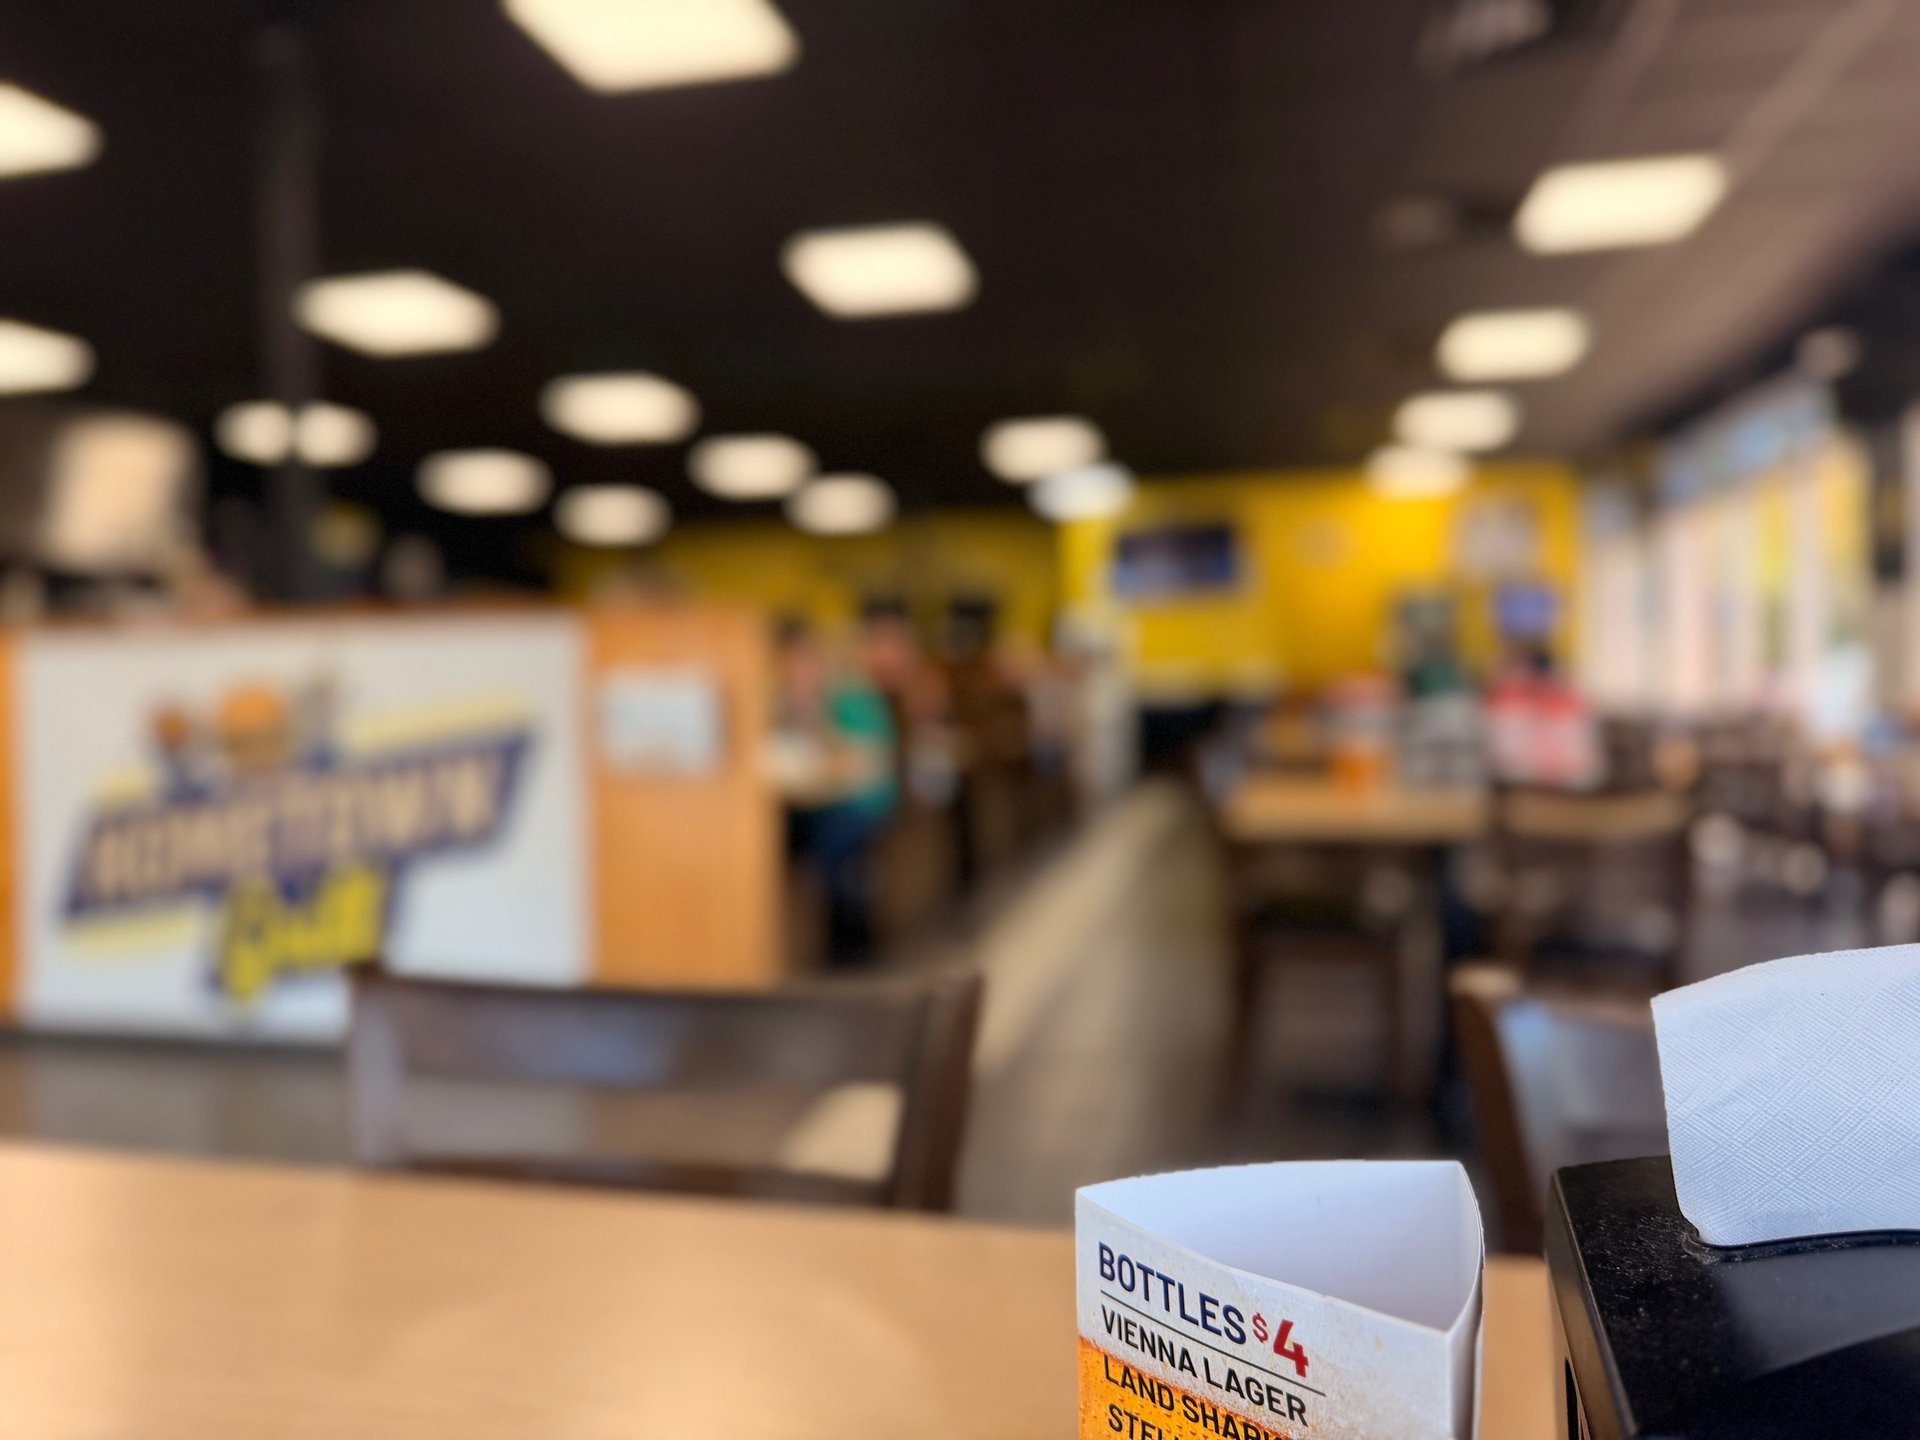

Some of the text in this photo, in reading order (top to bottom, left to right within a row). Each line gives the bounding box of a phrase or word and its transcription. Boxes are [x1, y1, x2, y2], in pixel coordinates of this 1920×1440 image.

[1098, 1241, 1247, 1345] BOTTLES
[1101, 1303, 1309, 1427] VIENNA LAGER
[1103, 1354, 1283, 1440] LAND SHAR
